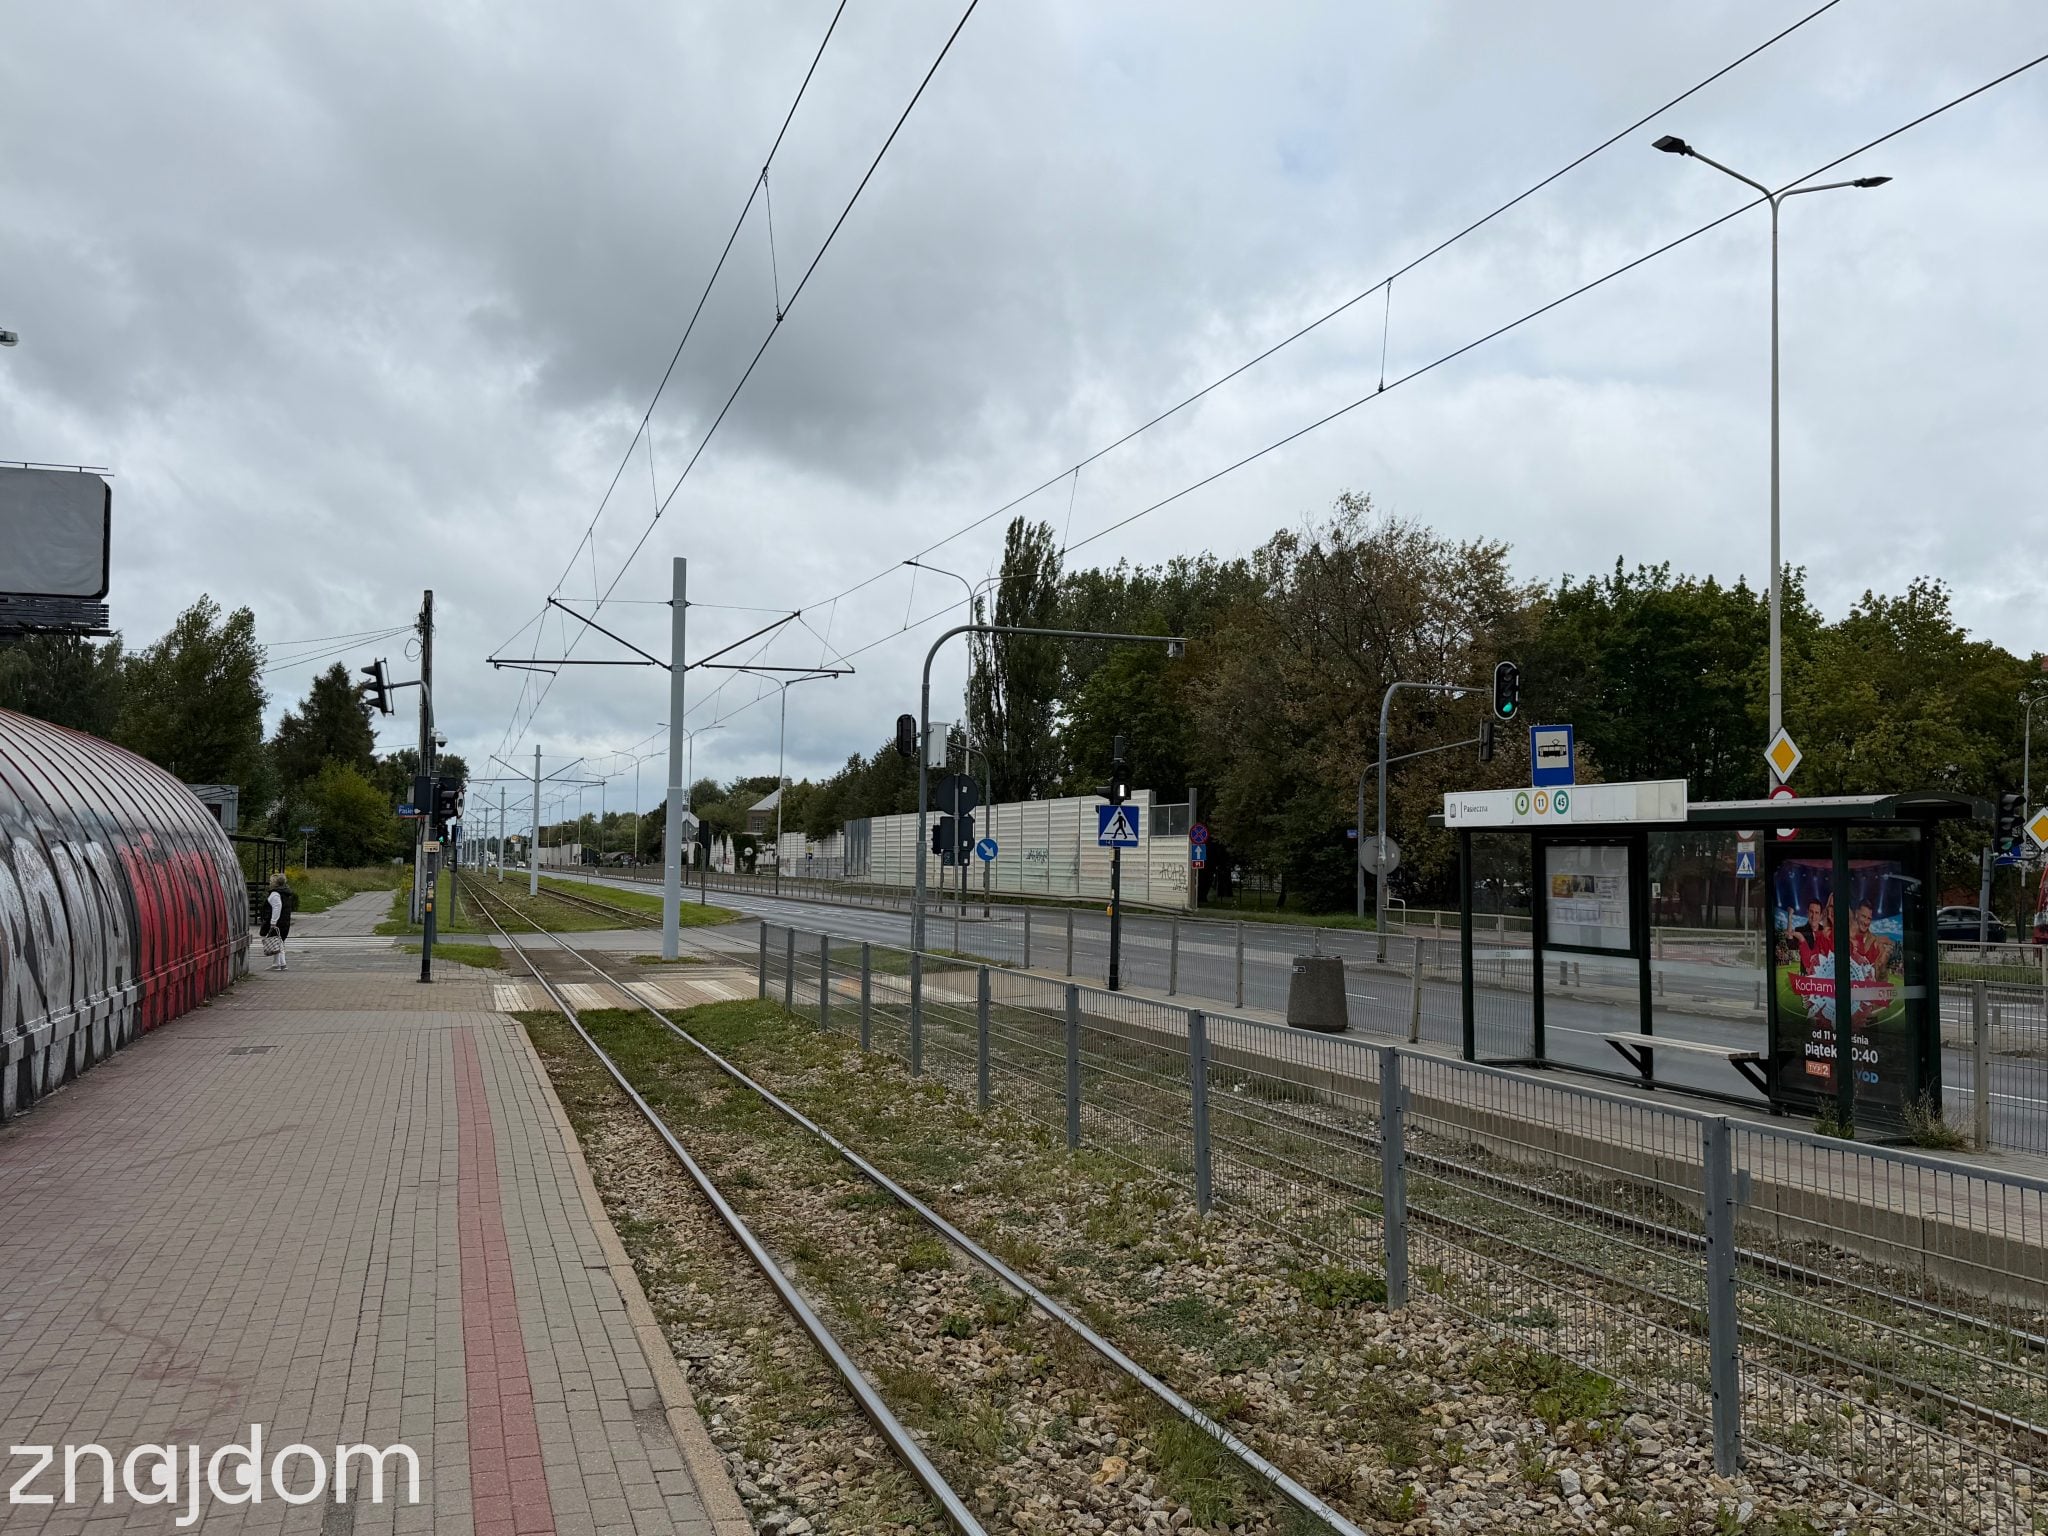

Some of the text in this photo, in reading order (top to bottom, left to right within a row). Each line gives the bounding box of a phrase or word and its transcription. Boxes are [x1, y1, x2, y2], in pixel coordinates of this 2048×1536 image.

[1520, 799, 1525, 808] 4
[1537, 799, 1545, 807] 11
[1557, 798, 1565, 807] 45
[1463, 804, 1488, 813] Pasieczna
[1795, 979, 1833, 993] Kocham
[1812, 1029, 1822, 1039] od
[1823, 1030, 1831, 1040] 11
[1805, 1041, 1879, 1064] piątek 0:40
